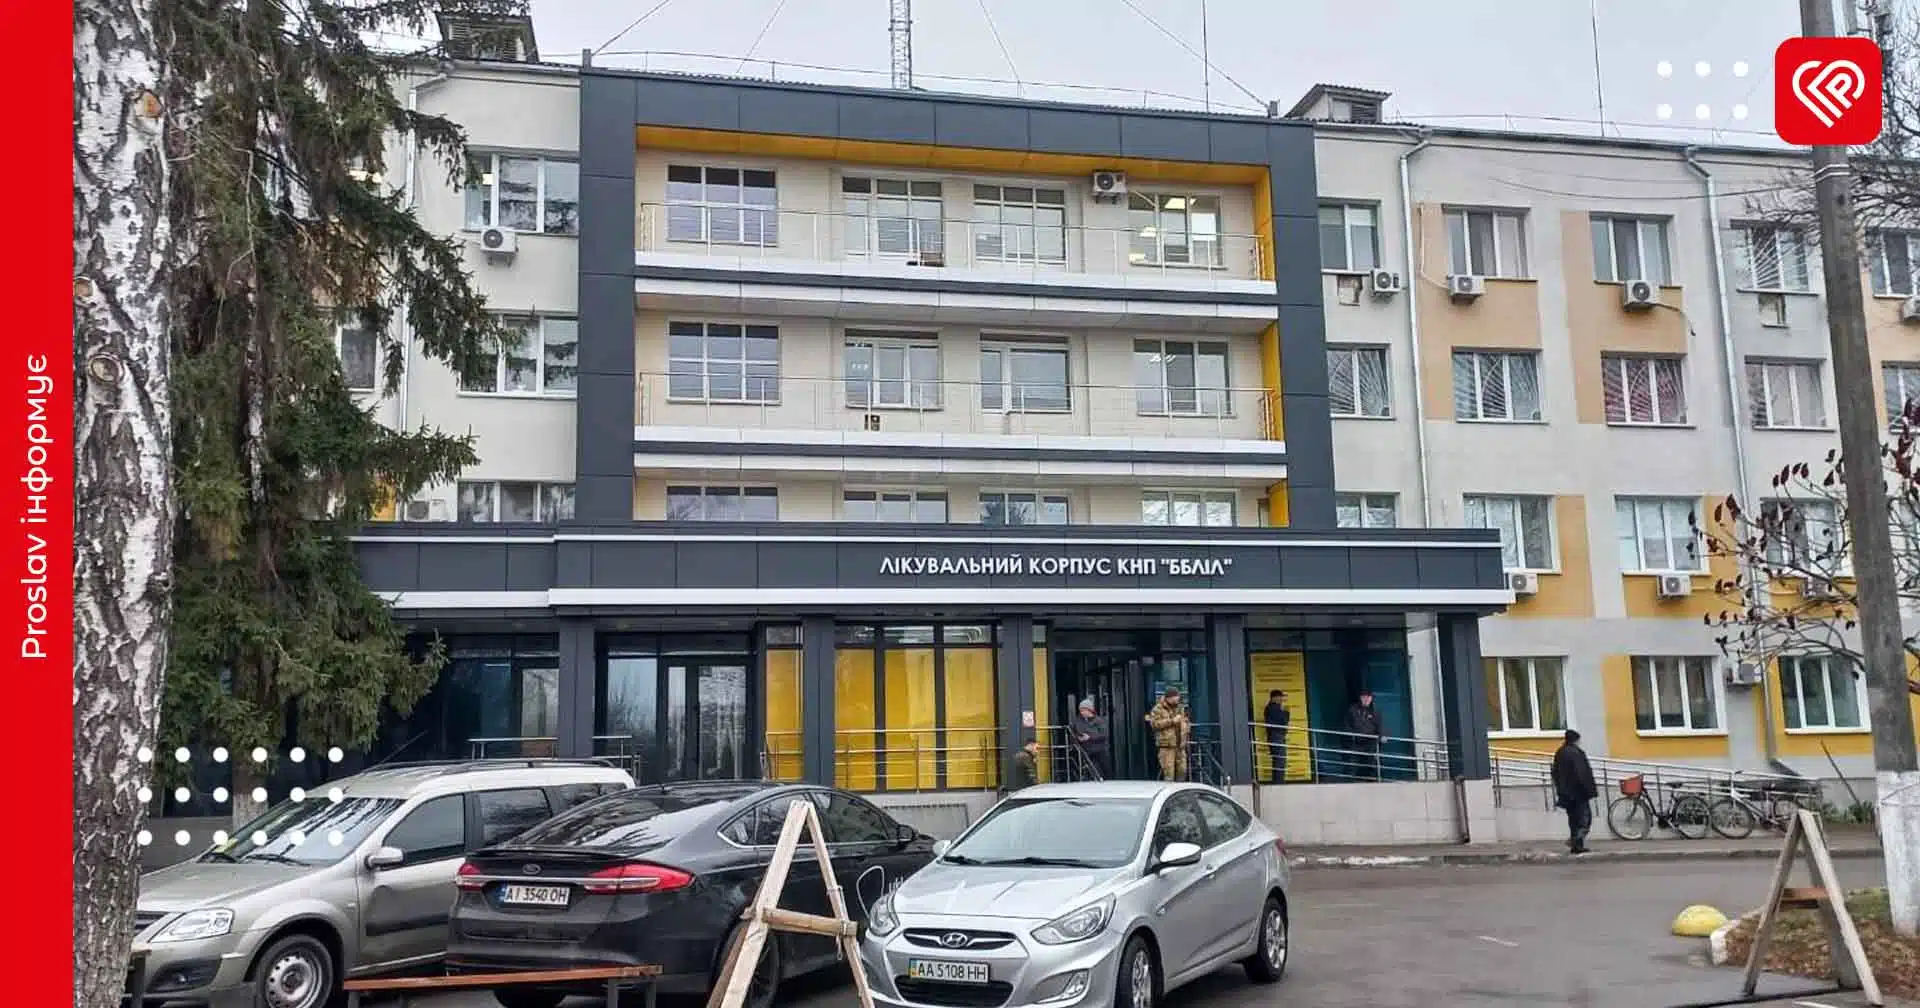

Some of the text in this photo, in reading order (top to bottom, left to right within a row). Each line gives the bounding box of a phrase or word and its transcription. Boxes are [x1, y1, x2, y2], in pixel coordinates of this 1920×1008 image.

[879, 553, 1233, 576] ЛІКУВАЛЬНИЙ КОРПУС КНП "ББЛІЛ"
[937, 963, 965, 978] 5108
